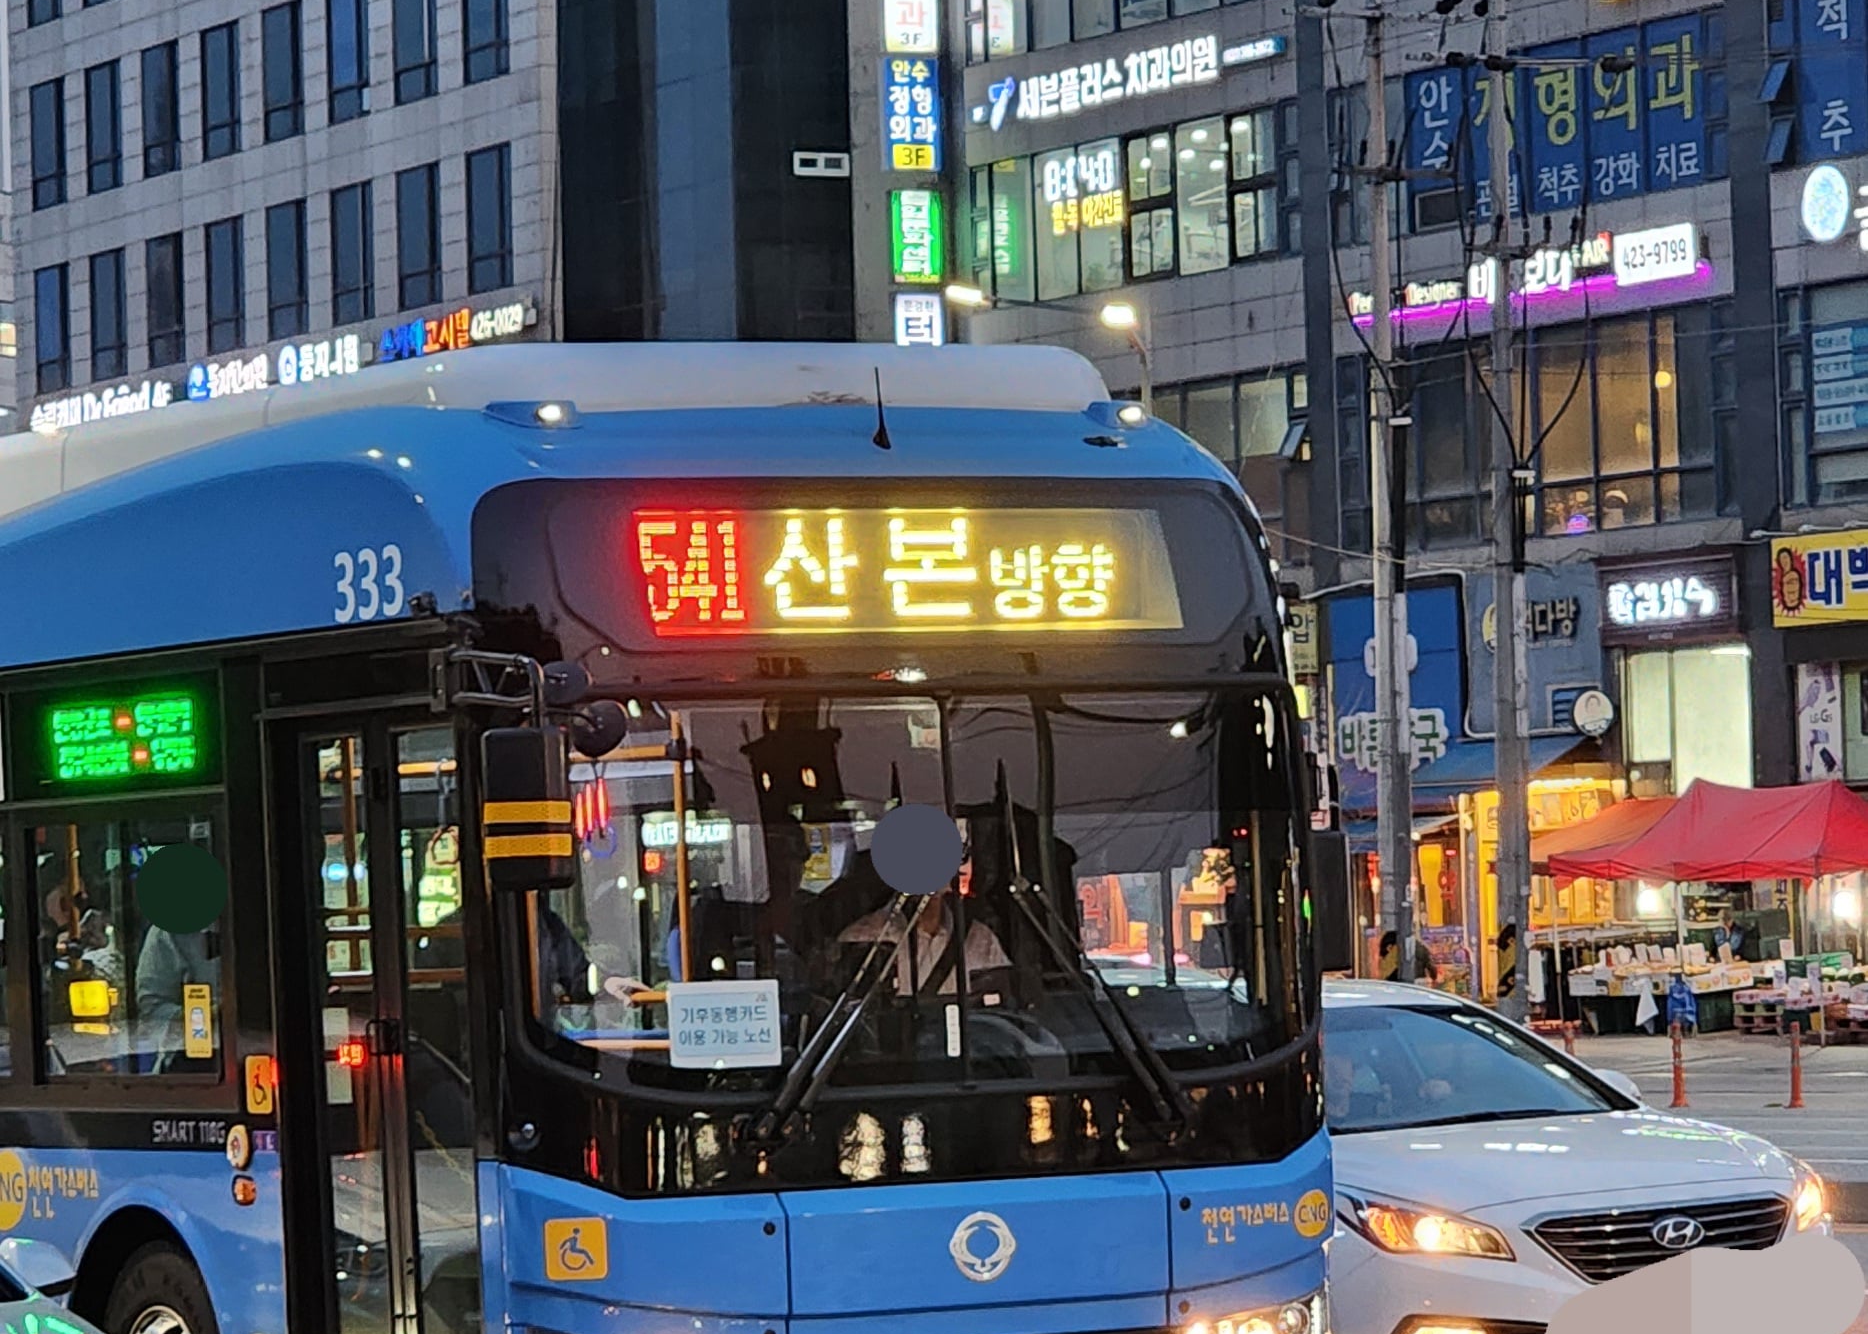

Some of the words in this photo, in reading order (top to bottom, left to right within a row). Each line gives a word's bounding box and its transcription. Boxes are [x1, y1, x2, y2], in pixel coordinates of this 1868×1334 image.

[900, 32, 923, 46] 3F
[891, 60, 931, 84] 안수
[888, 84, 933, 116] 정형
[889, 115, 937, 144] 외과
[901, 146, 926, 167] 3F
[1538, 163, 1581, 205] 척추
[1594, 150, 1640, 196] 강화
[1655, 141, 1700, 183] 치료
[1622, 237, 1688, 270] 423-9799
[333, 543, 403, 624] 333
[636, 518, 748, 623] 541
[989, 543, 1115, 619] 방향
[678, 1029, 706, 1046] 이용
[711, 1028, 738, 1045] 가능
[743, 1027, 772, 1044] 노선
[151, 1120, 197, 1145] SMART
[1201, 1199, 1290, 1245] 천연가스버스
[1298, 1199, 1331, 1226] CNG
